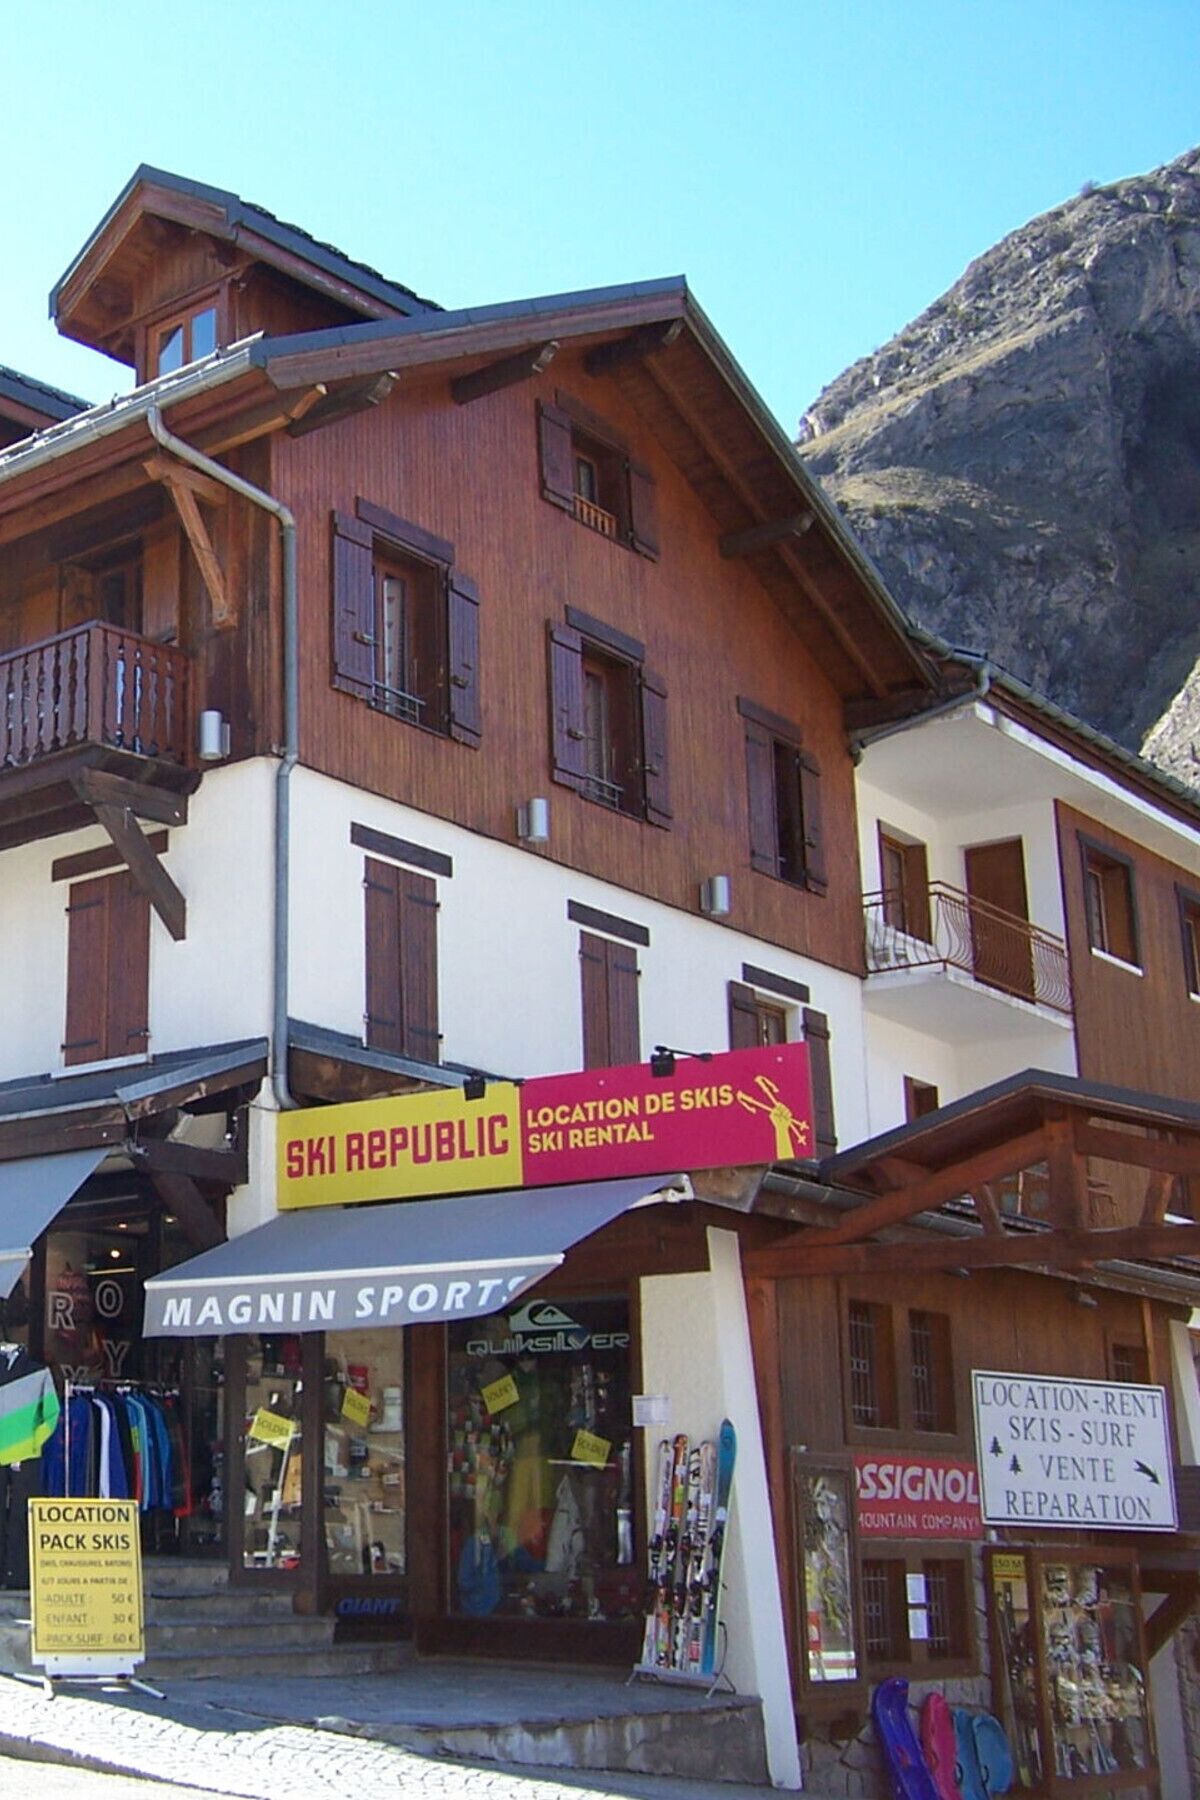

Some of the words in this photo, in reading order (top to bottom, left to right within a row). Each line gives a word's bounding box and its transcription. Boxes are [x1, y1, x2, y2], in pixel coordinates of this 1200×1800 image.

[526, 1096, 639, 1128] LOCATION
[645, 1091, 676, 1114] DE
[680, 1084, 734, 1110] SKIS
[528, 1130, 564, 1154] SKI
[568, 1121, 654, 1149] RENTAL
[286, 1136, 336, 1179] SKI
[162, 1288, 336, 1327] MAGNIN
[466, 1331, 631, 1357] QUIKSILVER
[1008, 1415, 1062, 1443] SKIS
[1081, 1420, 1137, 1448] SURF
[1038, 1454, 1117, 1483] VENTE
[855, 1463, 980, 1504] SSIGNOL
[38, 1506, 130, 1523] LOCATION
[1005, 1490, 1152, 1521] REPARATION
[40, 1534, 87, 1550] PACK
[92, 1534, 131, 1550] SKIS
[111, 1593, 125, 1604] 50
[338, 1598, 401, 1613] GIANT
[113, 1613, 125, 1624] 30
[112, 1633, 127, 1644] 60
